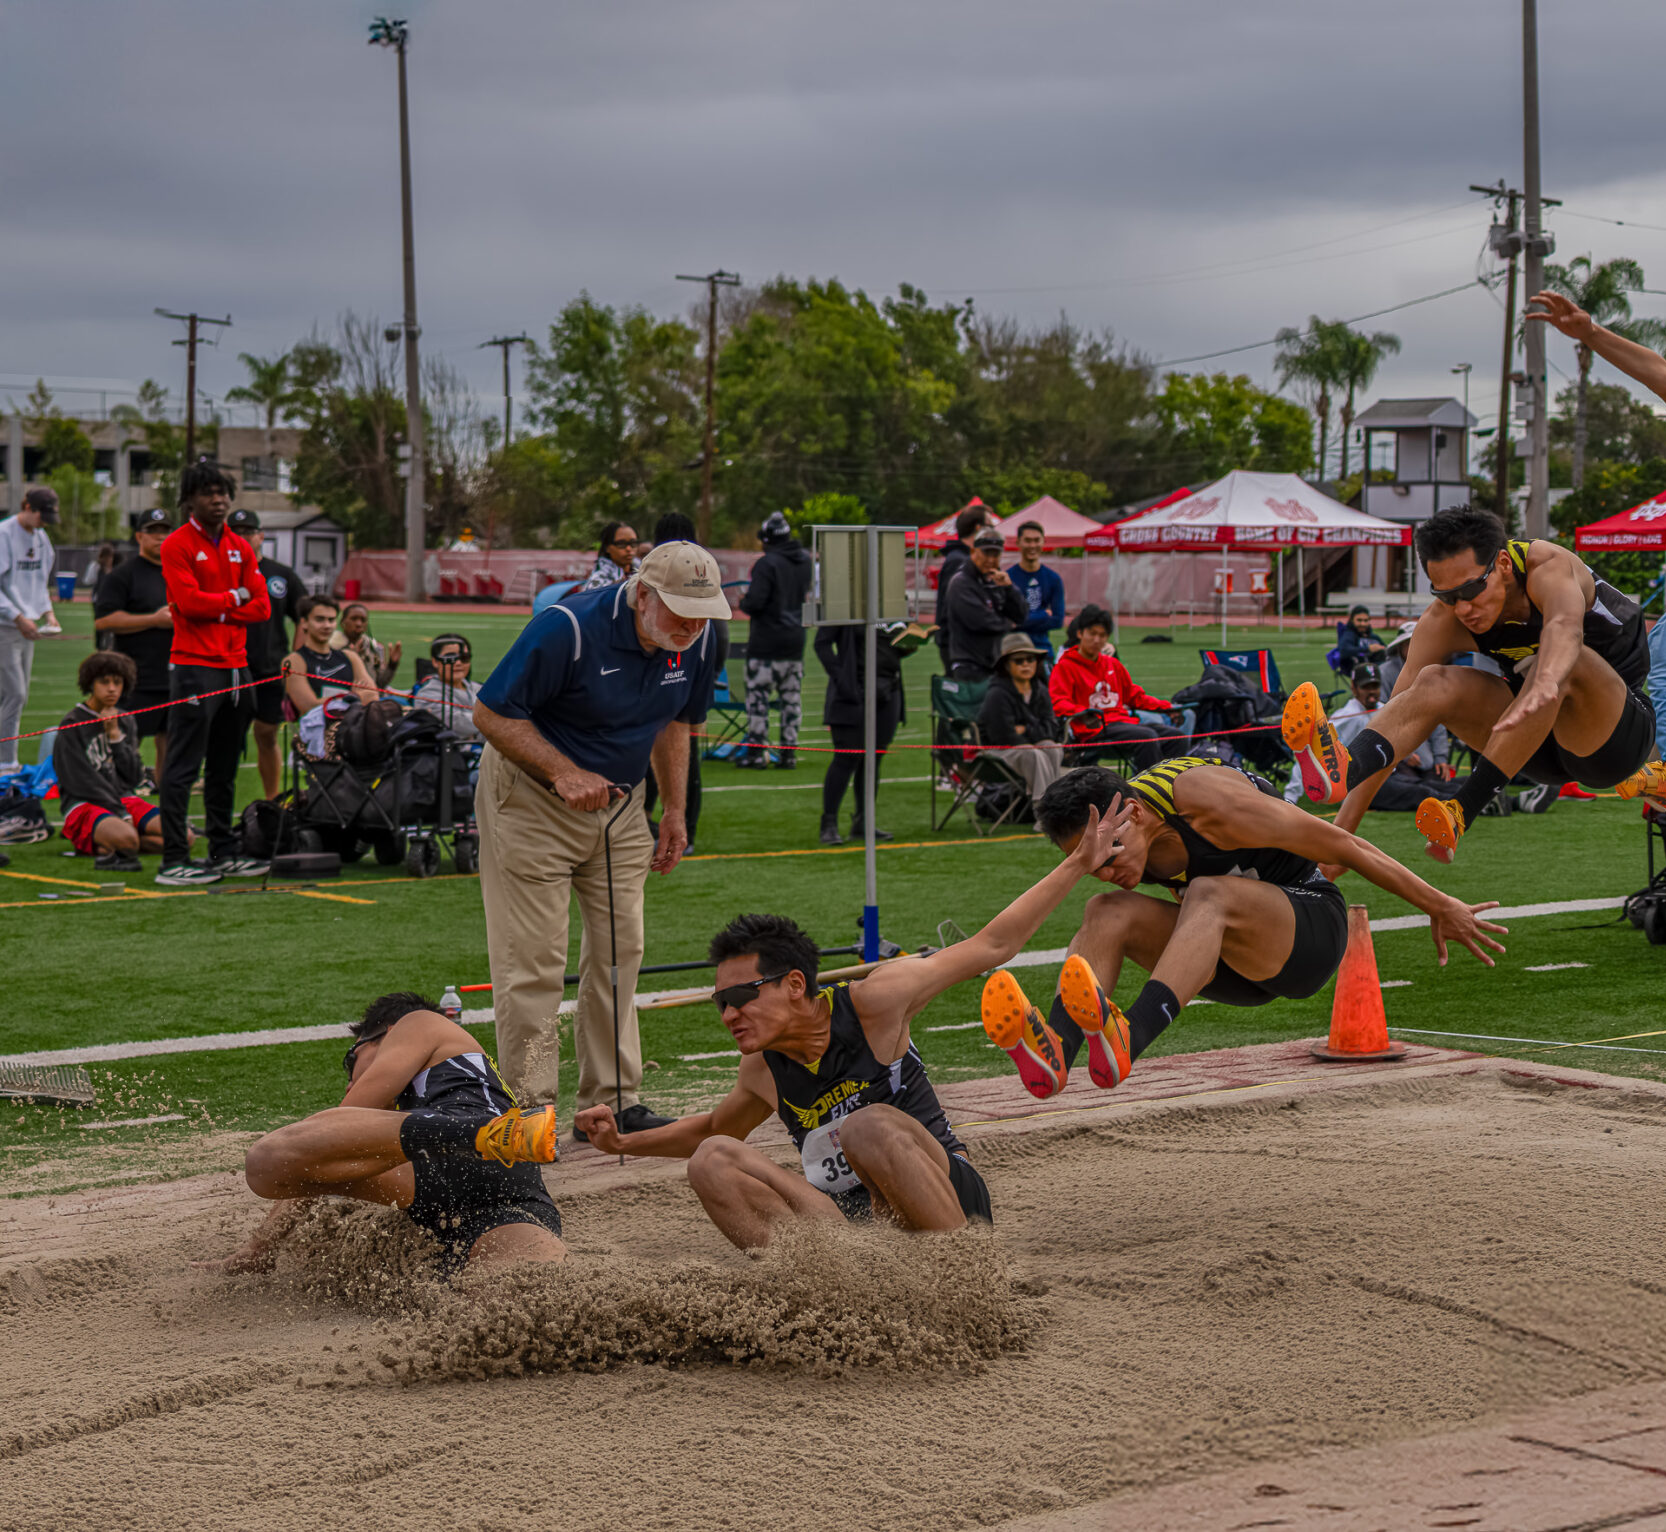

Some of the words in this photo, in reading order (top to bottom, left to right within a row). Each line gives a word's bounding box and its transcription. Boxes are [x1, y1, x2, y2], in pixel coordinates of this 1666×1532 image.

[1161, 524, 1218, 543] COUNTRY
[1234, 526, 1275, 542] HOME
[1276, 526, 1294, 542] OF
[1322, 526, 1403, 544] CHAMPIONS
[1613, 533, 1638, 545] GLORY
[664, 670, 685, 680] USATF
[821, 1150, 854, 1182] 39
